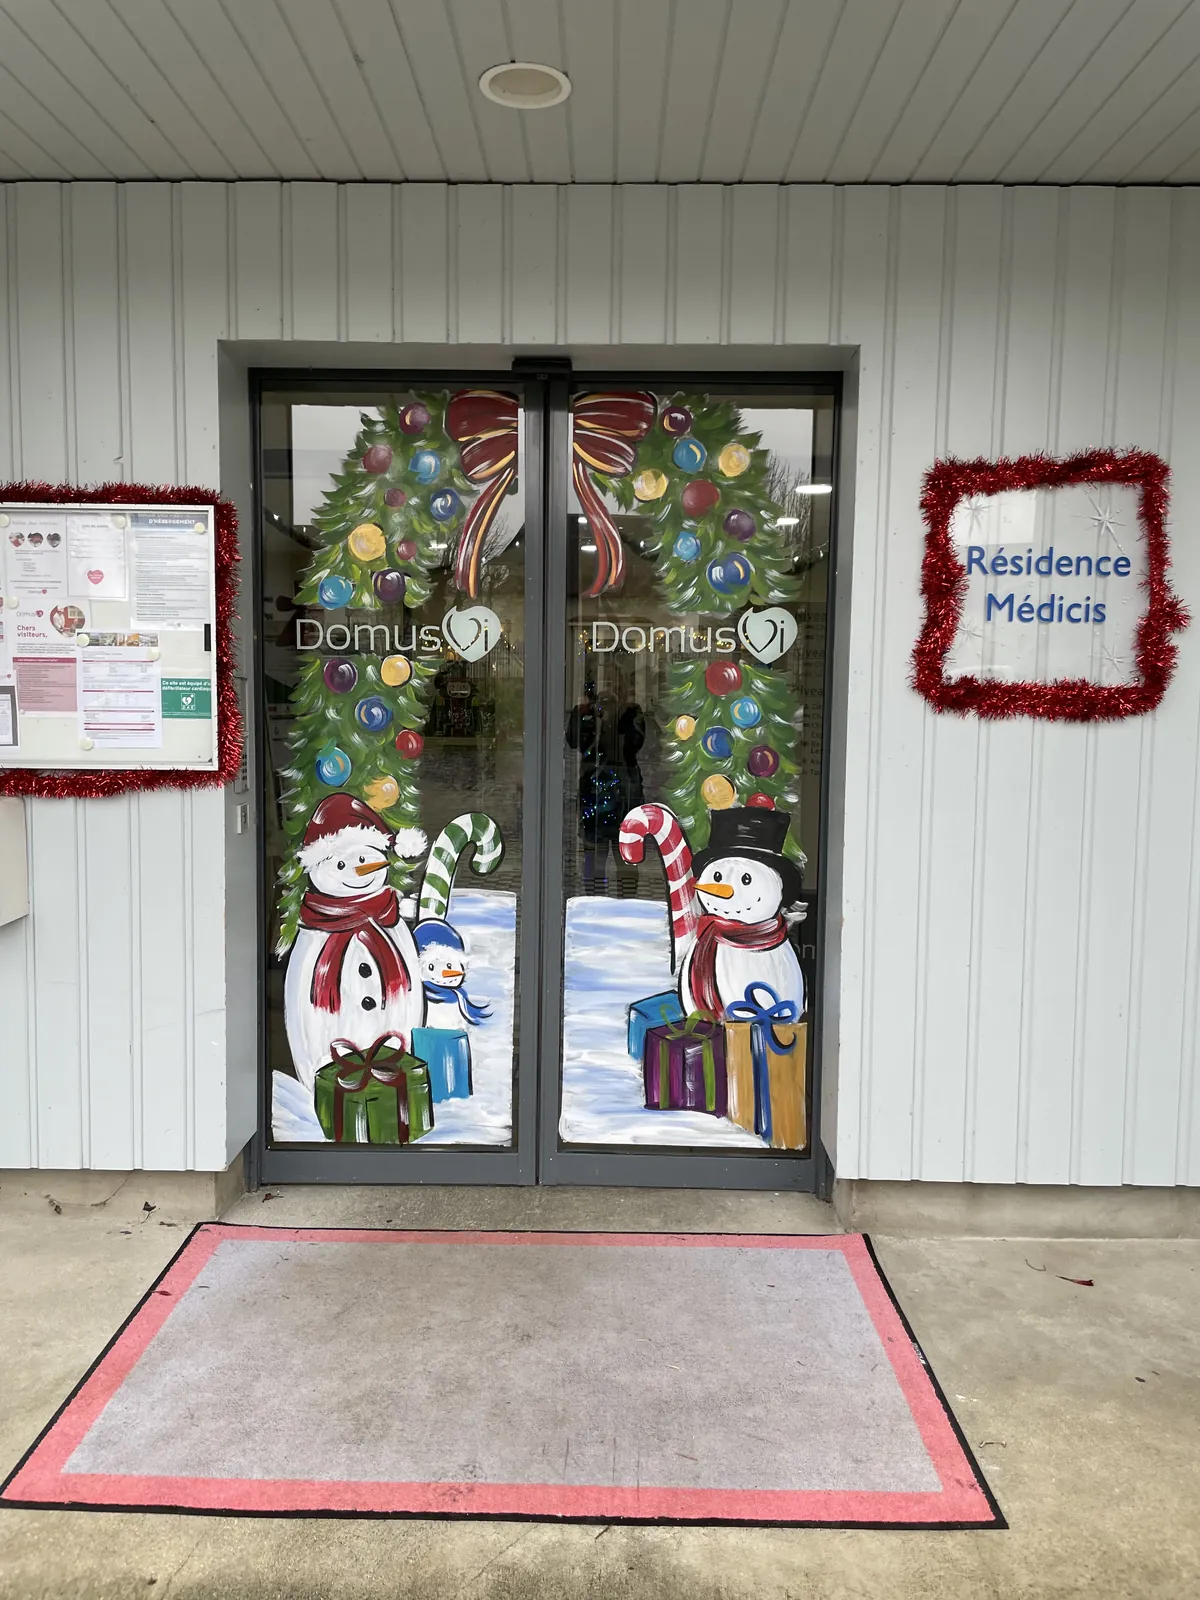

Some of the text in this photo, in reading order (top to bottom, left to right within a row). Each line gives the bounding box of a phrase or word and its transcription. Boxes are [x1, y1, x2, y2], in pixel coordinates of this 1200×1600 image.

[967, 546, 1132, 577] Résidence
[986, 593, 1107, 624] Médicis
[16, 624, 36, 632] Chers
[16, 631, 49, 639] visiteurs,
